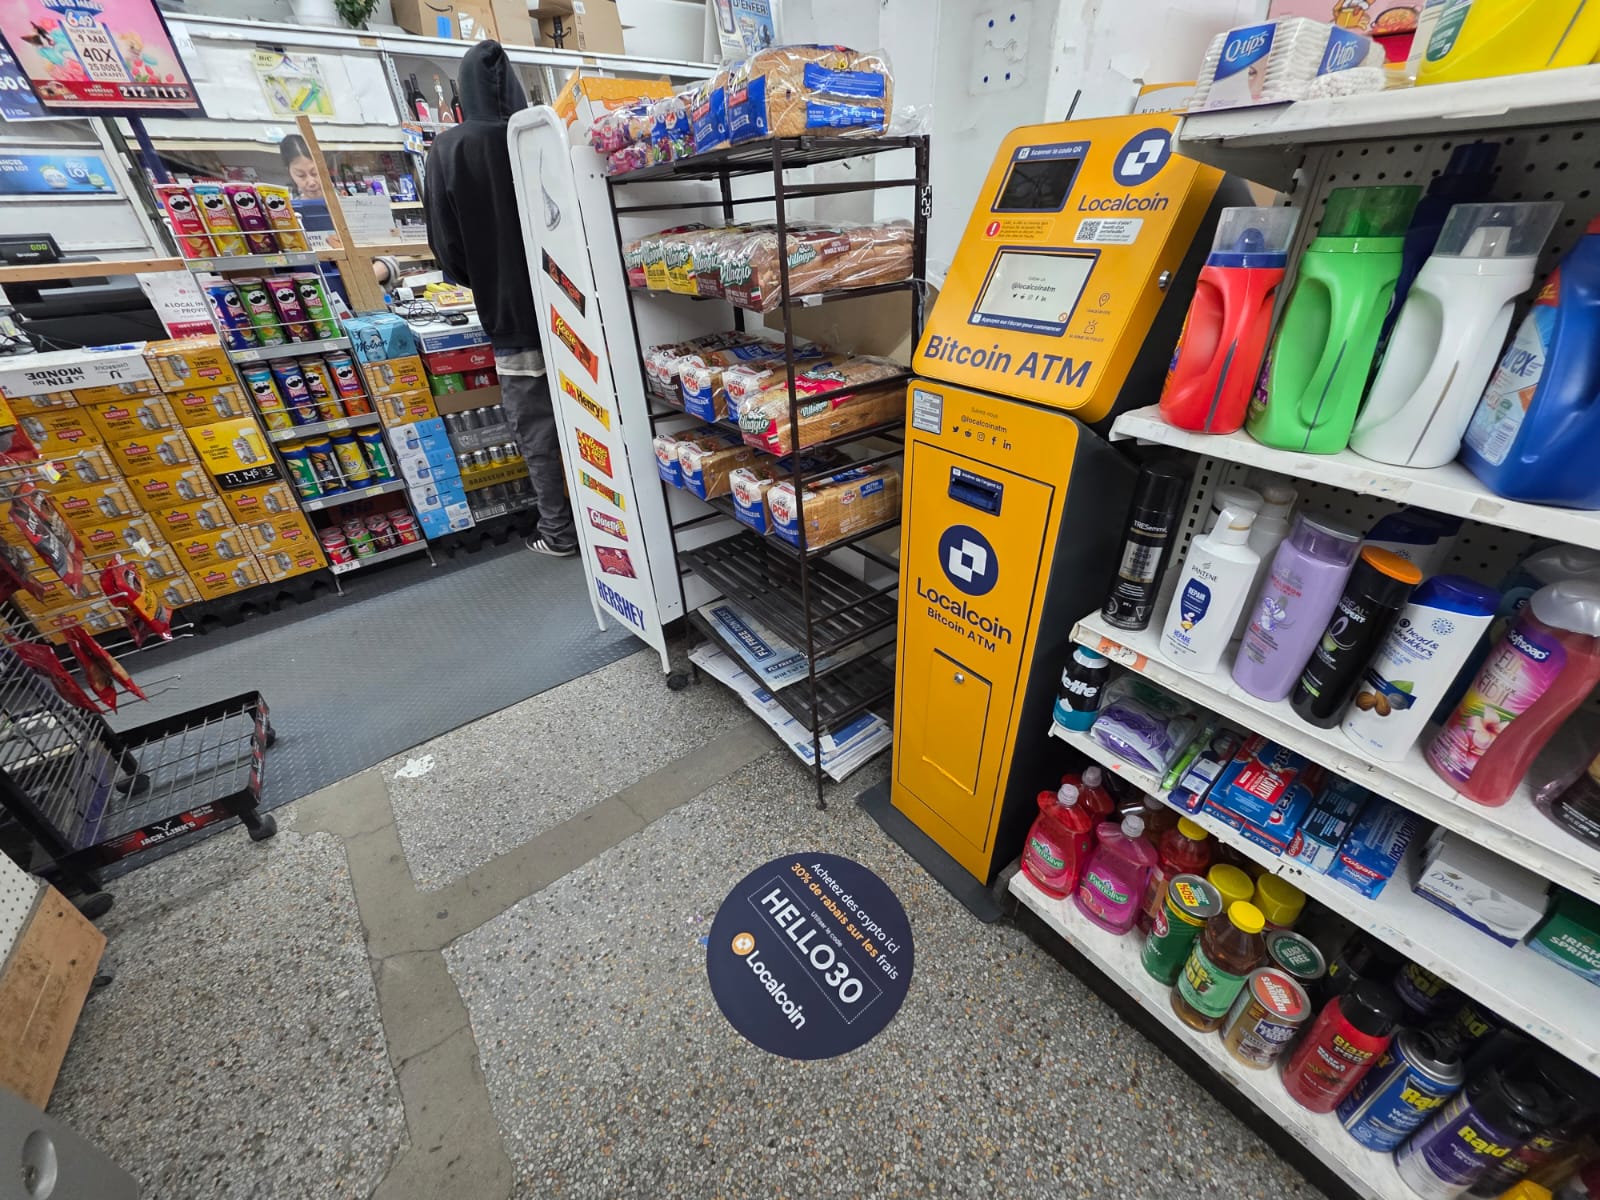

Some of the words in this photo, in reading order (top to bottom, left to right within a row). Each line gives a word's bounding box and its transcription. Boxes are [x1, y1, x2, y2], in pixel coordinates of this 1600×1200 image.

[120, 86, 147, 98] 212
[153, 87, 176, 99] 711
[1078, 192, 1169, 212] Localcoin
[719, 263, 751, 287] Villaggio
[355, 337, 387, 353] Molson
[924, 334, 1012, 375] Bitcoin
[1015, 351, 1093, 388] ATM
[25, 366, 84, 381] MONDE
[46, 375, 73, 387] FIN
[683, 376, 698, 391] POM
[728, 382, 745, 396] POM
[576, 388, 604, 418] Henry!
[801, 401, 828, 417] Villaggio
[739, 414, 770, 434] Villaggio
[961, 414, 1008, 433] @localcoinatm
[734, 488, 751, 503] POM
[772, 505, 789, 521] POM
[1191, 564, 1218, 583] PANTENE
[595, 576, 646, 632] HERSHEY
[1188, 586, 1207, 601] REPAIR
[917, 577, 1013, 645] Localcoin
[737, 628, 758, 648] FREE
[927, 606, 965, 636] Bitcoin
[967, 630, 996, 653] ATM
[1407, 624, 1431, 646] head
[750, 642, 769, 659] FLY
[1508, 628, 1549, 661] Softsoap
[140, 833, 164, 846] JACK
[165, 820, 196, 839] LINK'S
[1030, 837, 1065, 870] Palmolive
[1342, 855, 1379, 879] Colgate
[1088, 871, 1129, 905] Palmolive
[1430, 871, 1464, 892] Dove
[811, 862, 845, 898] Achetez
[841, 892, 859, 913] des
[856, 909, 887, 941] crypto
[884, 935, 901, 955] ici
[791, 862, 813, 885] 30%
[808, 881, 822, 898] de
[819, 894, 850, 926] rabais
[846, 922, 864, 942] sur
[861, 935, 879, 958] les
[875, 953, 900, 981] frais
[761, 887, 864, 1004] HELLO30
[830, 932, 844, 949] code
[1287, 952, 1311, 967] FREE
[745, 949, 807, 1031] Localcoin
[1260, 976, 1288, 1012] REMOVES
[1333, 1034, 1373, 1059] Blaze
[1457, 1125, 1512, 1158] Raid
